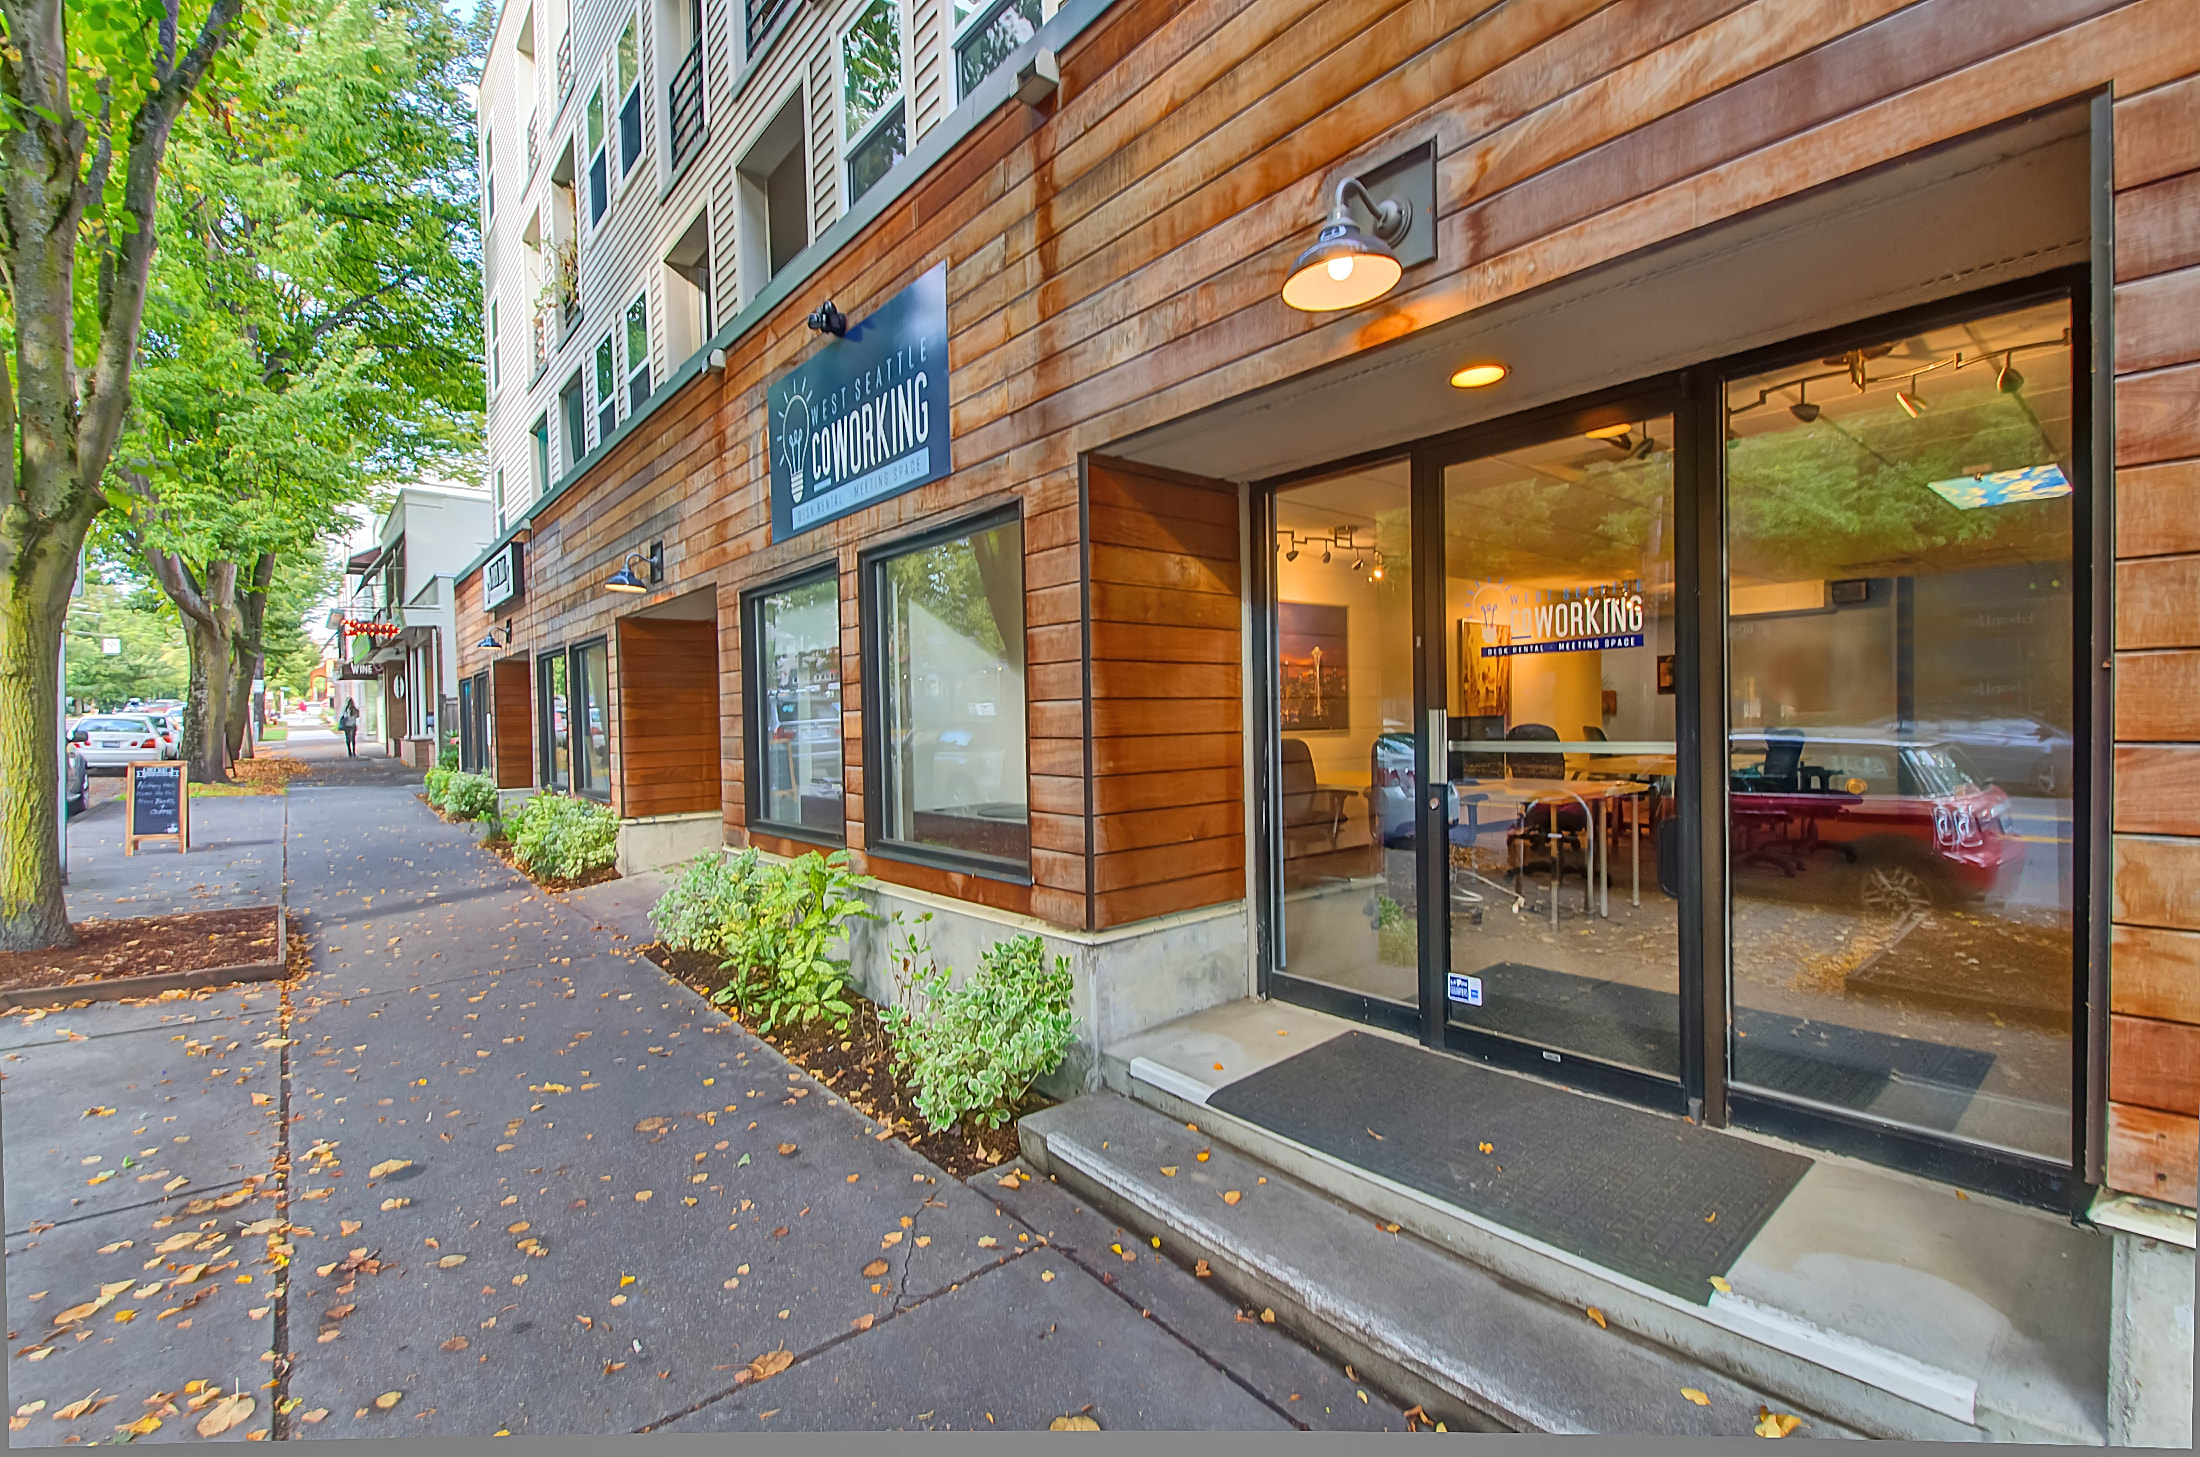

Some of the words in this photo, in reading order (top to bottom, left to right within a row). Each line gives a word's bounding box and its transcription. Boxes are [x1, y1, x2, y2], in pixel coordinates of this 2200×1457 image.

[811, 386, 846, 426] WEST
[854, 337, 928, 401] SEATTLE
[811, 371, 929, 483] COWORKING
[816, 494, 843, 515] RENTAL
[853, 473, 889, 497] MEETING
[892, 457, 921, 481] SPACE
[1510, 589, 1552, 605] WEST
[1563, 578, 1642, 600] SEATTLE
[1510, 594, 1643, 639] COWORKING
[1487, 647, 1509, 656] DESK
[1512, 644, 1544, 654] RENTAL
[1558, 639, 1600, 651] MEETING
[1604, 636, 1636, 648] SPACE
[350, 663, 373, 675] WINE
